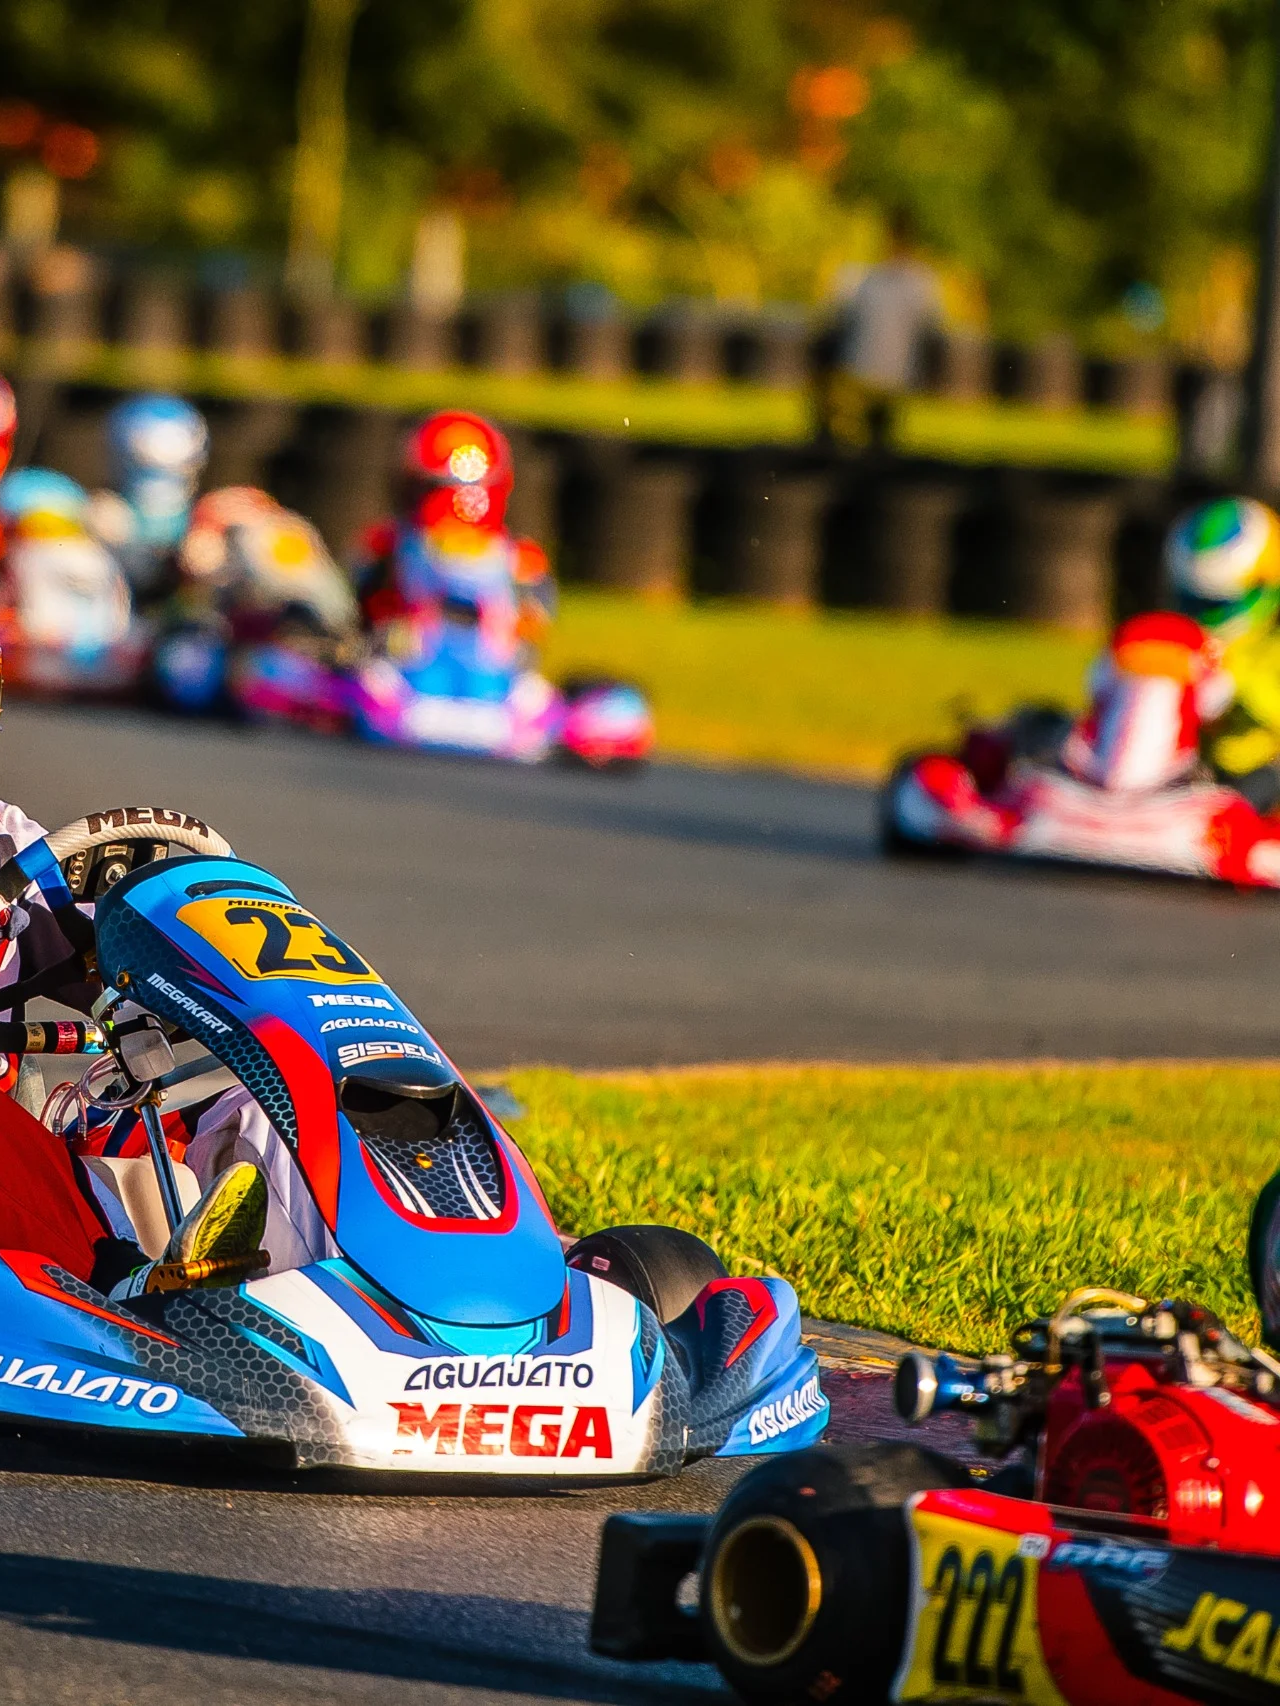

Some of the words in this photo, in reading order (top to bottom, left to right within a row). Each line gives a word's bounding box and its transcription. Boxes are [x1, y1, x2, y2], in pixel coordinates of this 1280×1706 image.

[85, 806, 209, 838] MEGA
[225, 908, 370, 975] 23
[146, 972, 233, 1034] MEGAKART
[308, 994, 395, 1011] MEGA
[320, 1018, 419, 1034] AGUAJATO
[337, 1041, 442, 1065] SISDELI
[404, 1361, 594, 1391] AGUAJATO
[387, 1402, 613, 1459] MEGA
[933, 1544, 1026, 1692] 222
